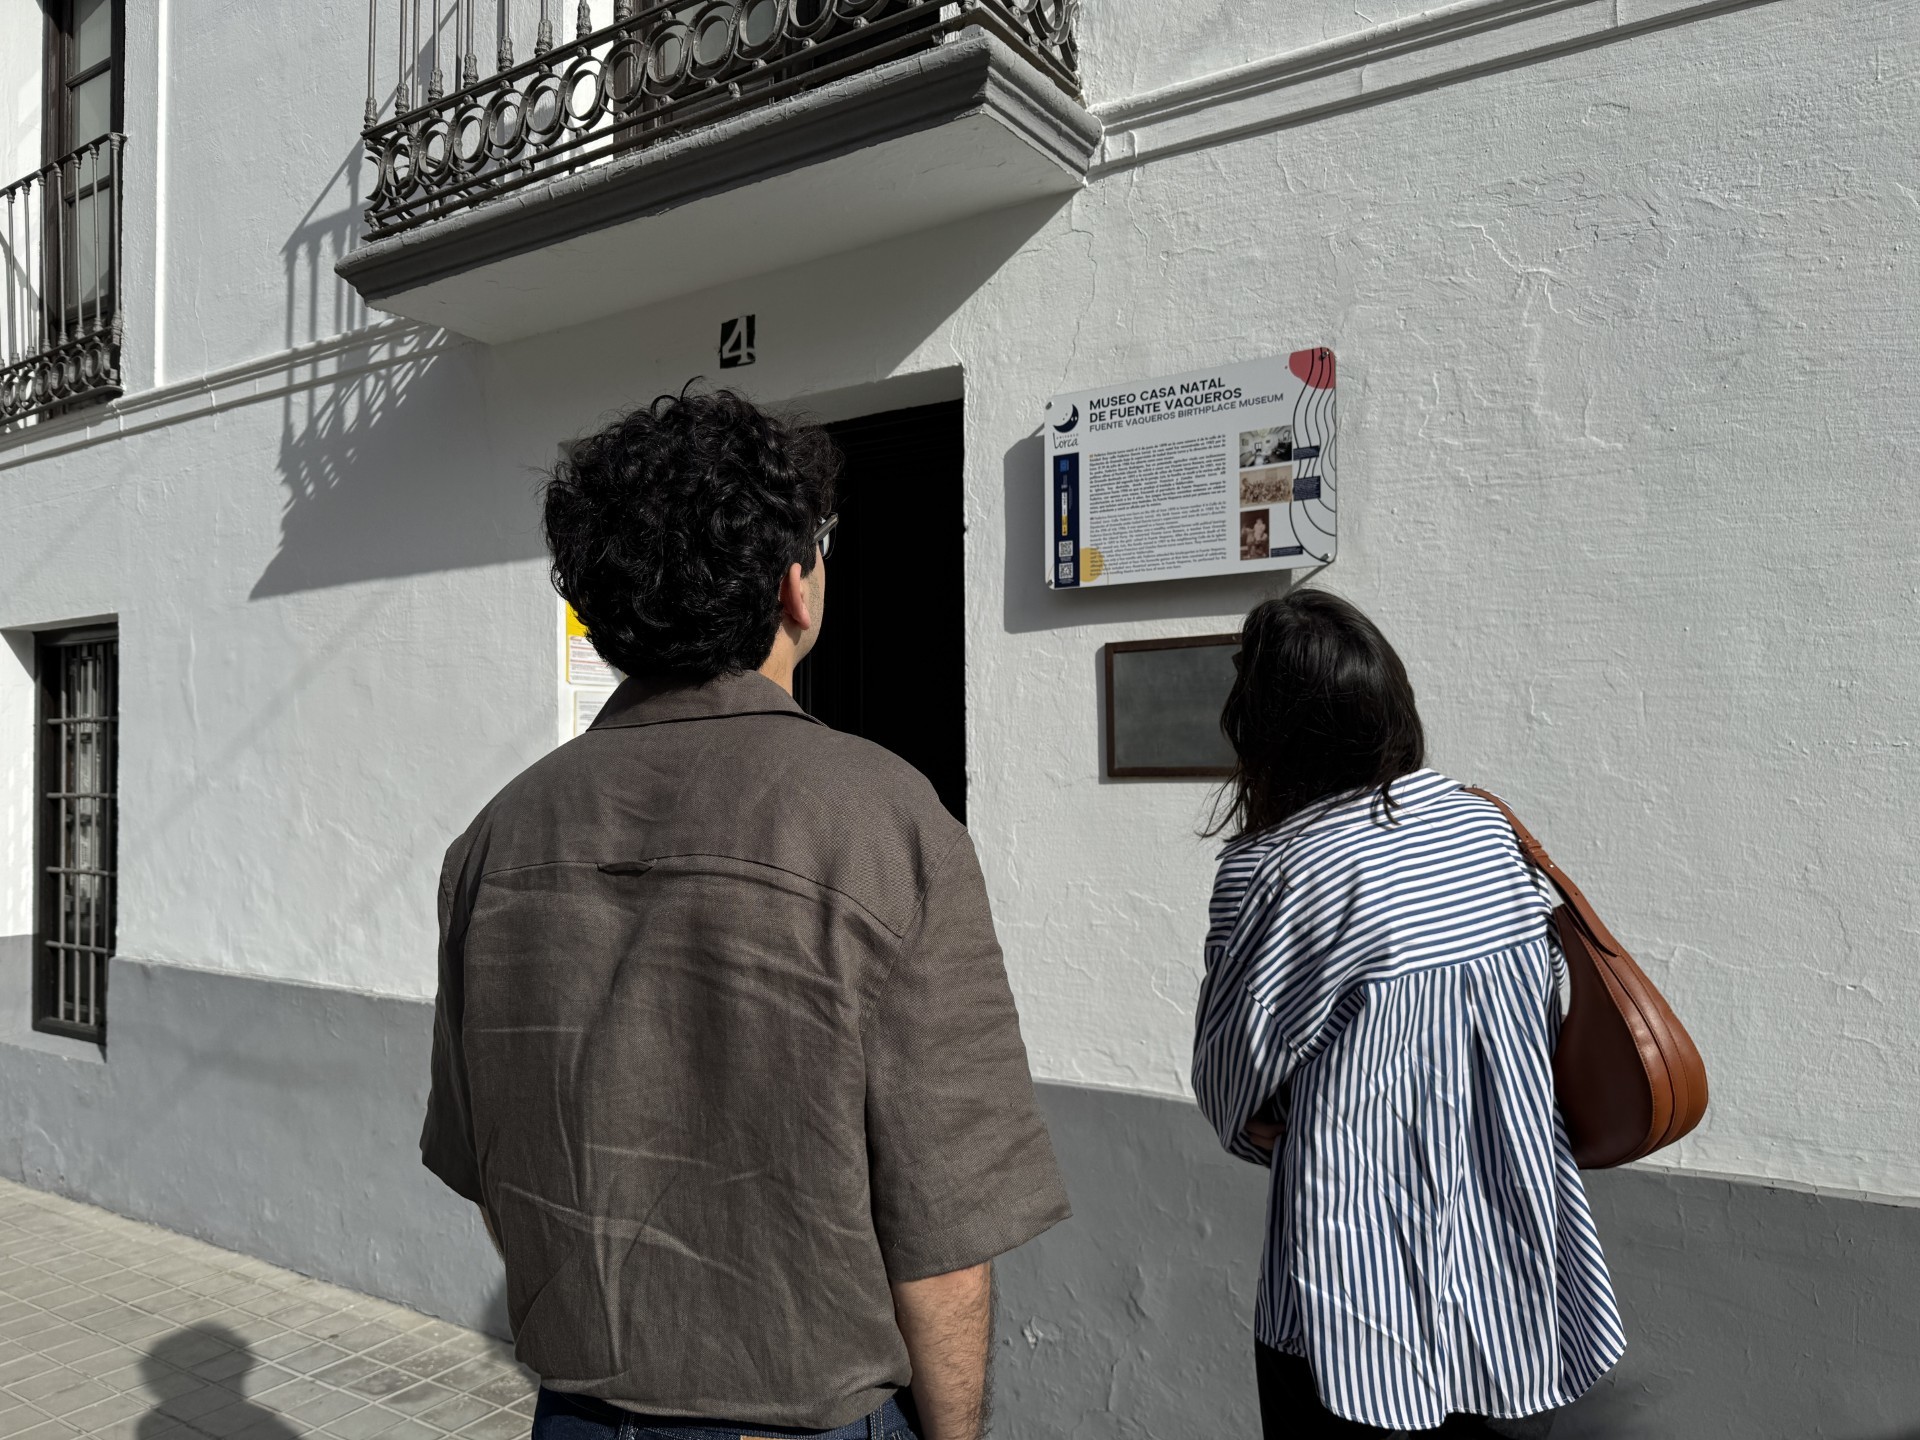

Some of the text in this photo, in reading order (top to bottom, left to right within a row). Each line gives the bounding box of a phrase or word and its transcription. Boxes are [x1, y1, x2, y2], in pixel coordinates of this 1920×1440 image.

[722, 315, 755, 365] 4
[1089, 377, 1226, 411] MUSEO CASA NATAL
[1089, 388, 1242, 424] DE FUENTE VAQUEROS
[1089, 393, 1284, 432] FUENTE VAQUEROS BIRTHPLACE MUSEUM
[1053, 432, 1079, 449] Lorca
